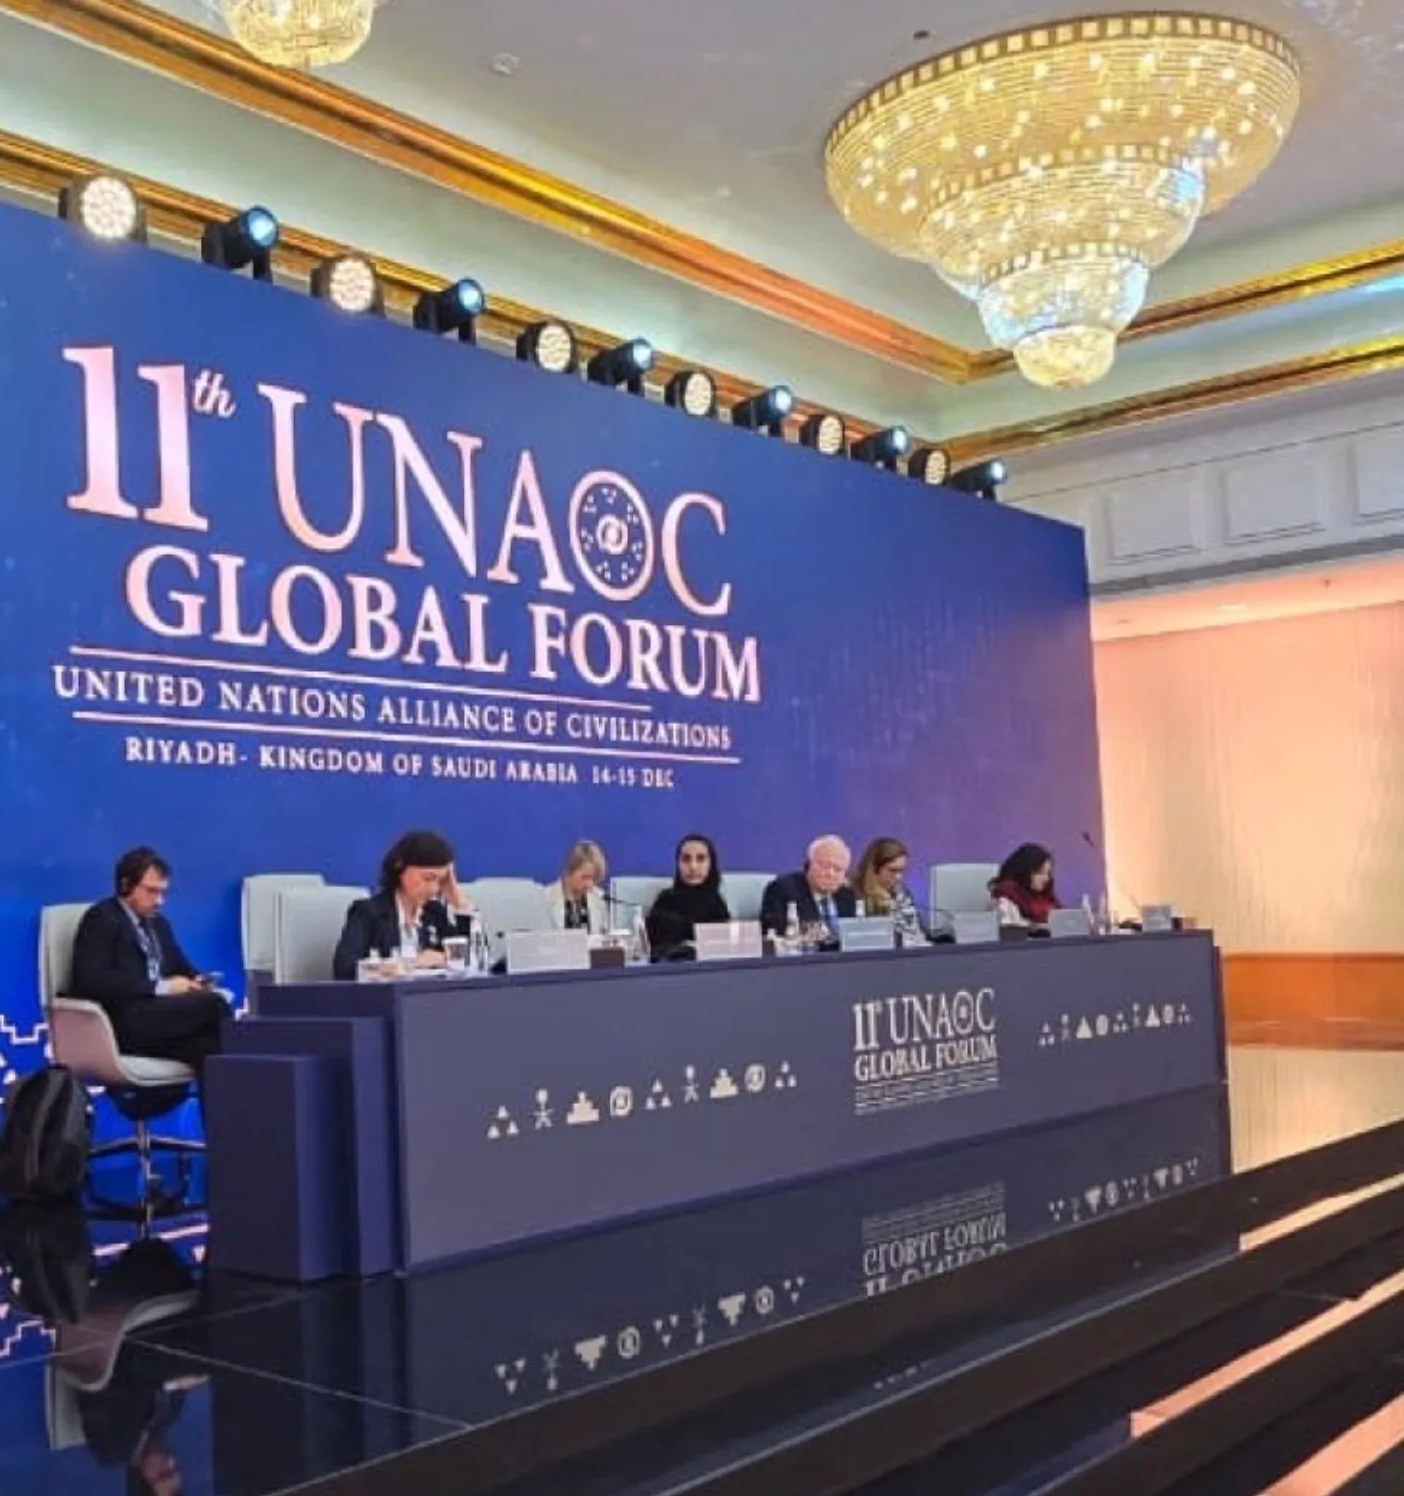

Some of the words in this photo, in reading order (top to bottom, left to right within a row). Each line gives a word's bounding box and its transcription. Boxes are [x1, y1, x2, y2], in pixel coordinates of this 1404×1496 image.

[62, 345, 238, 532] 11th
[258, 383, 733, 617] UNAOC
[125, 544, 508, 675] GLOBAL
[528, 602, 763, 703] FORUM
[52, 664, 206, 707] UNITED
[218, 681, 366, 722] NATIONS
[377, 696, 517, 734] ALLIANCE
[524, 710, 559, 738] OF
[566, 713, 732, 751] CIVILIZATIONS
[258, 744, 384, 775] KINGDOM
[392, 753, 422, 777] OF
[432, 754, 496, 780] SAUDI
[505, 760, 578, 785] ARABIA
[592, 764, 636, 788] 14-15
[642, 766, 676, 789] DEC
[884, 987, 997, 1046] UNAOC
[854, 1045, 933, 1082] GLOBAL
[935, 1034, 999, 1070] FORUM
